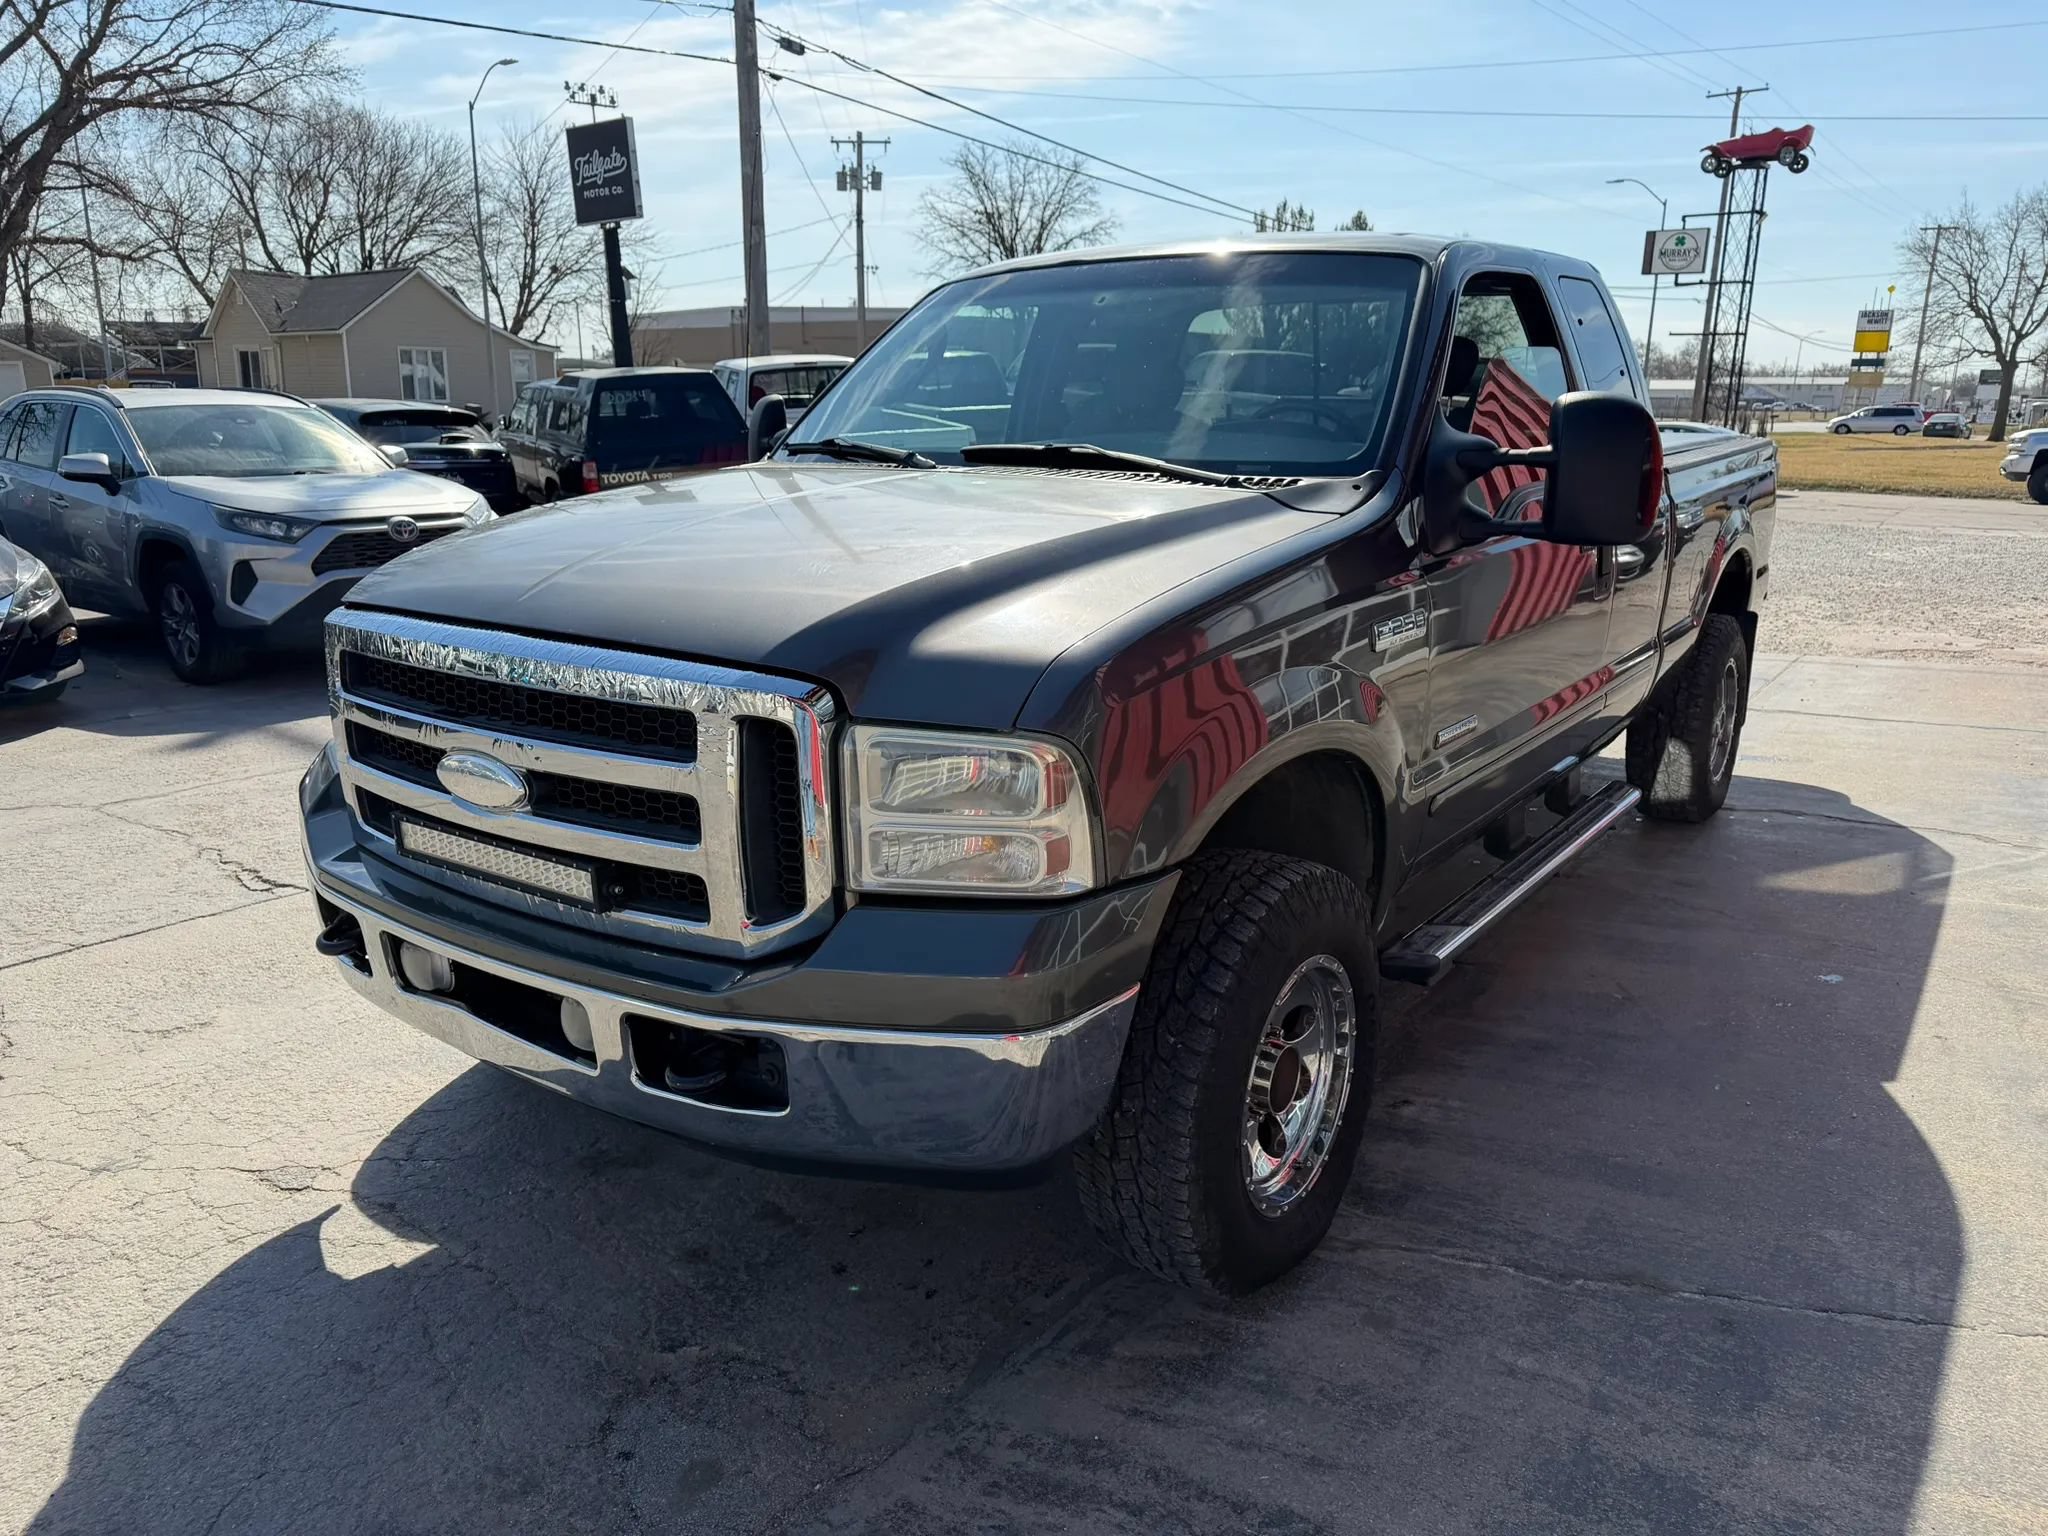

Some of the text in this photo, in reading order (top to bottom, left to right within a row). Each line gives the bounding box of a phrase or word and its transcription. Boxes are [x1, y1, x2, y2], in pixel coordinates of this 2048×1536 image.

[574, 146, 627, 186] Tailgate
[584, 187, 610, 199] MOTOR
[1659, 247, 1700, 259] MURRAY'S
[602, 471, 673, 484] TOYOTA T100
